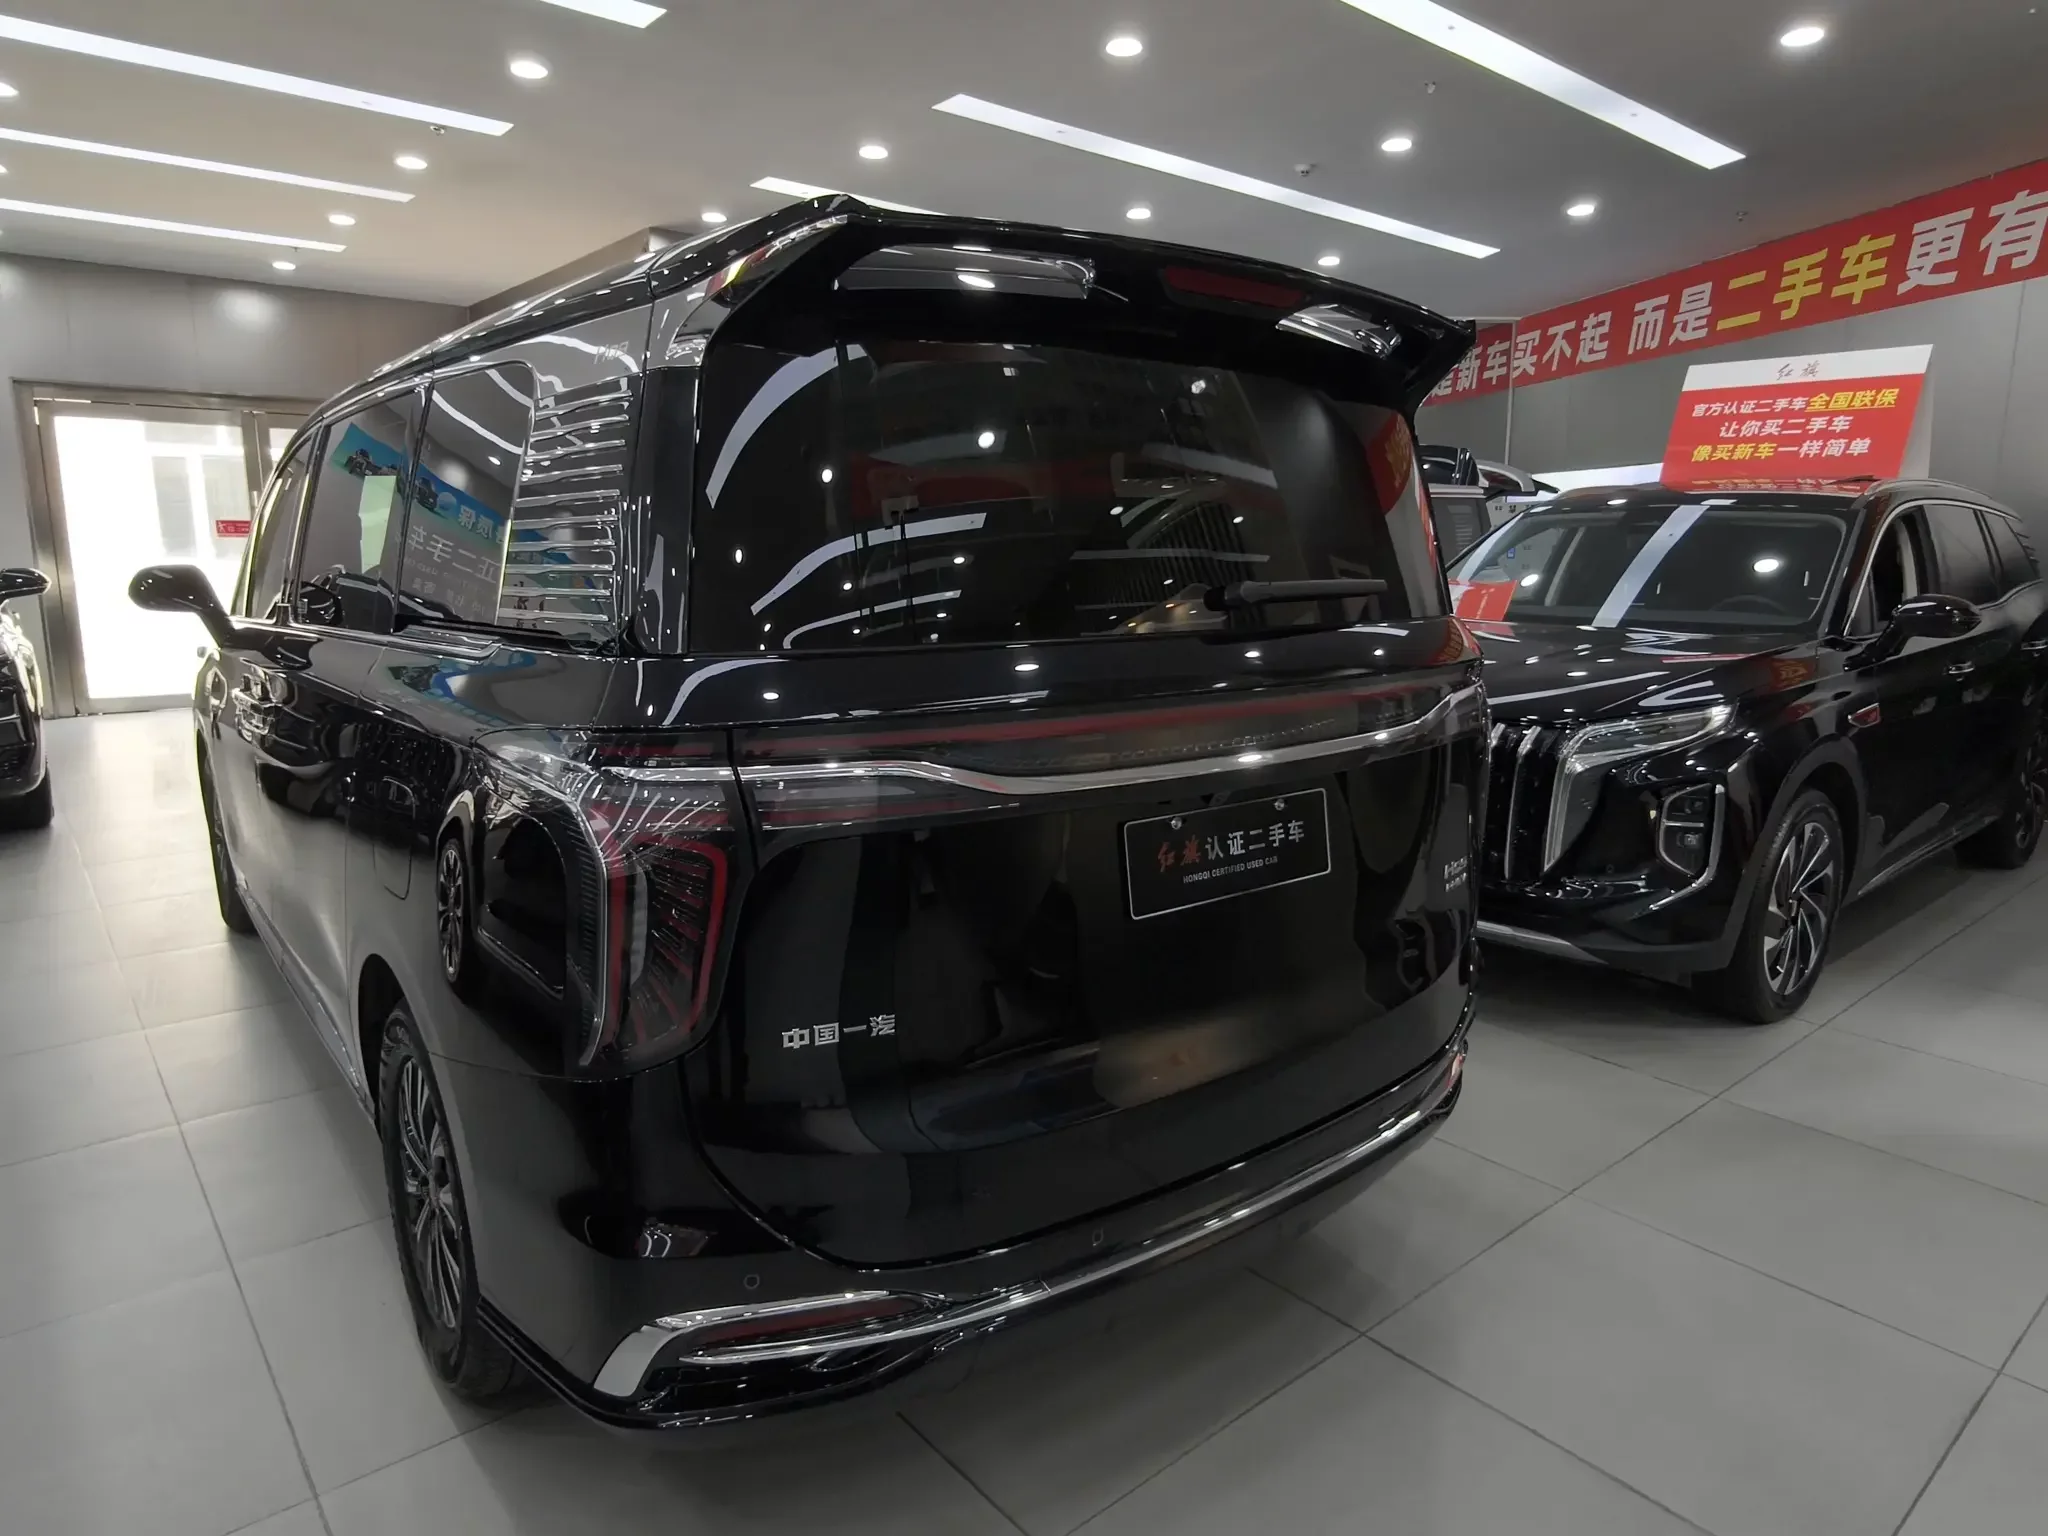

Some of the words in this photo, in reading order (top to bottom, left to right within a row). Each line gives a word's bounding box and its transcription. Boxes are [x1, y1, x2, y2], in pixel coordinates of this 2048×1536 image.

[1692, 388, 1899, 417] 官方认证二手车全国联保
[1719, 415, 1854, 438] 让你买二手车
[1691, 437, 1872, 462] 像买新车一样简单
[1183, 870, 1211, 884] HONGQI
[1212, 863, 1245, 878] CERTIFIED
[1247, 859, 1264, 870] USED
[1265, 855, 1279, 865] CAR
[782, 1014, 896, 1049] 中国一汽
